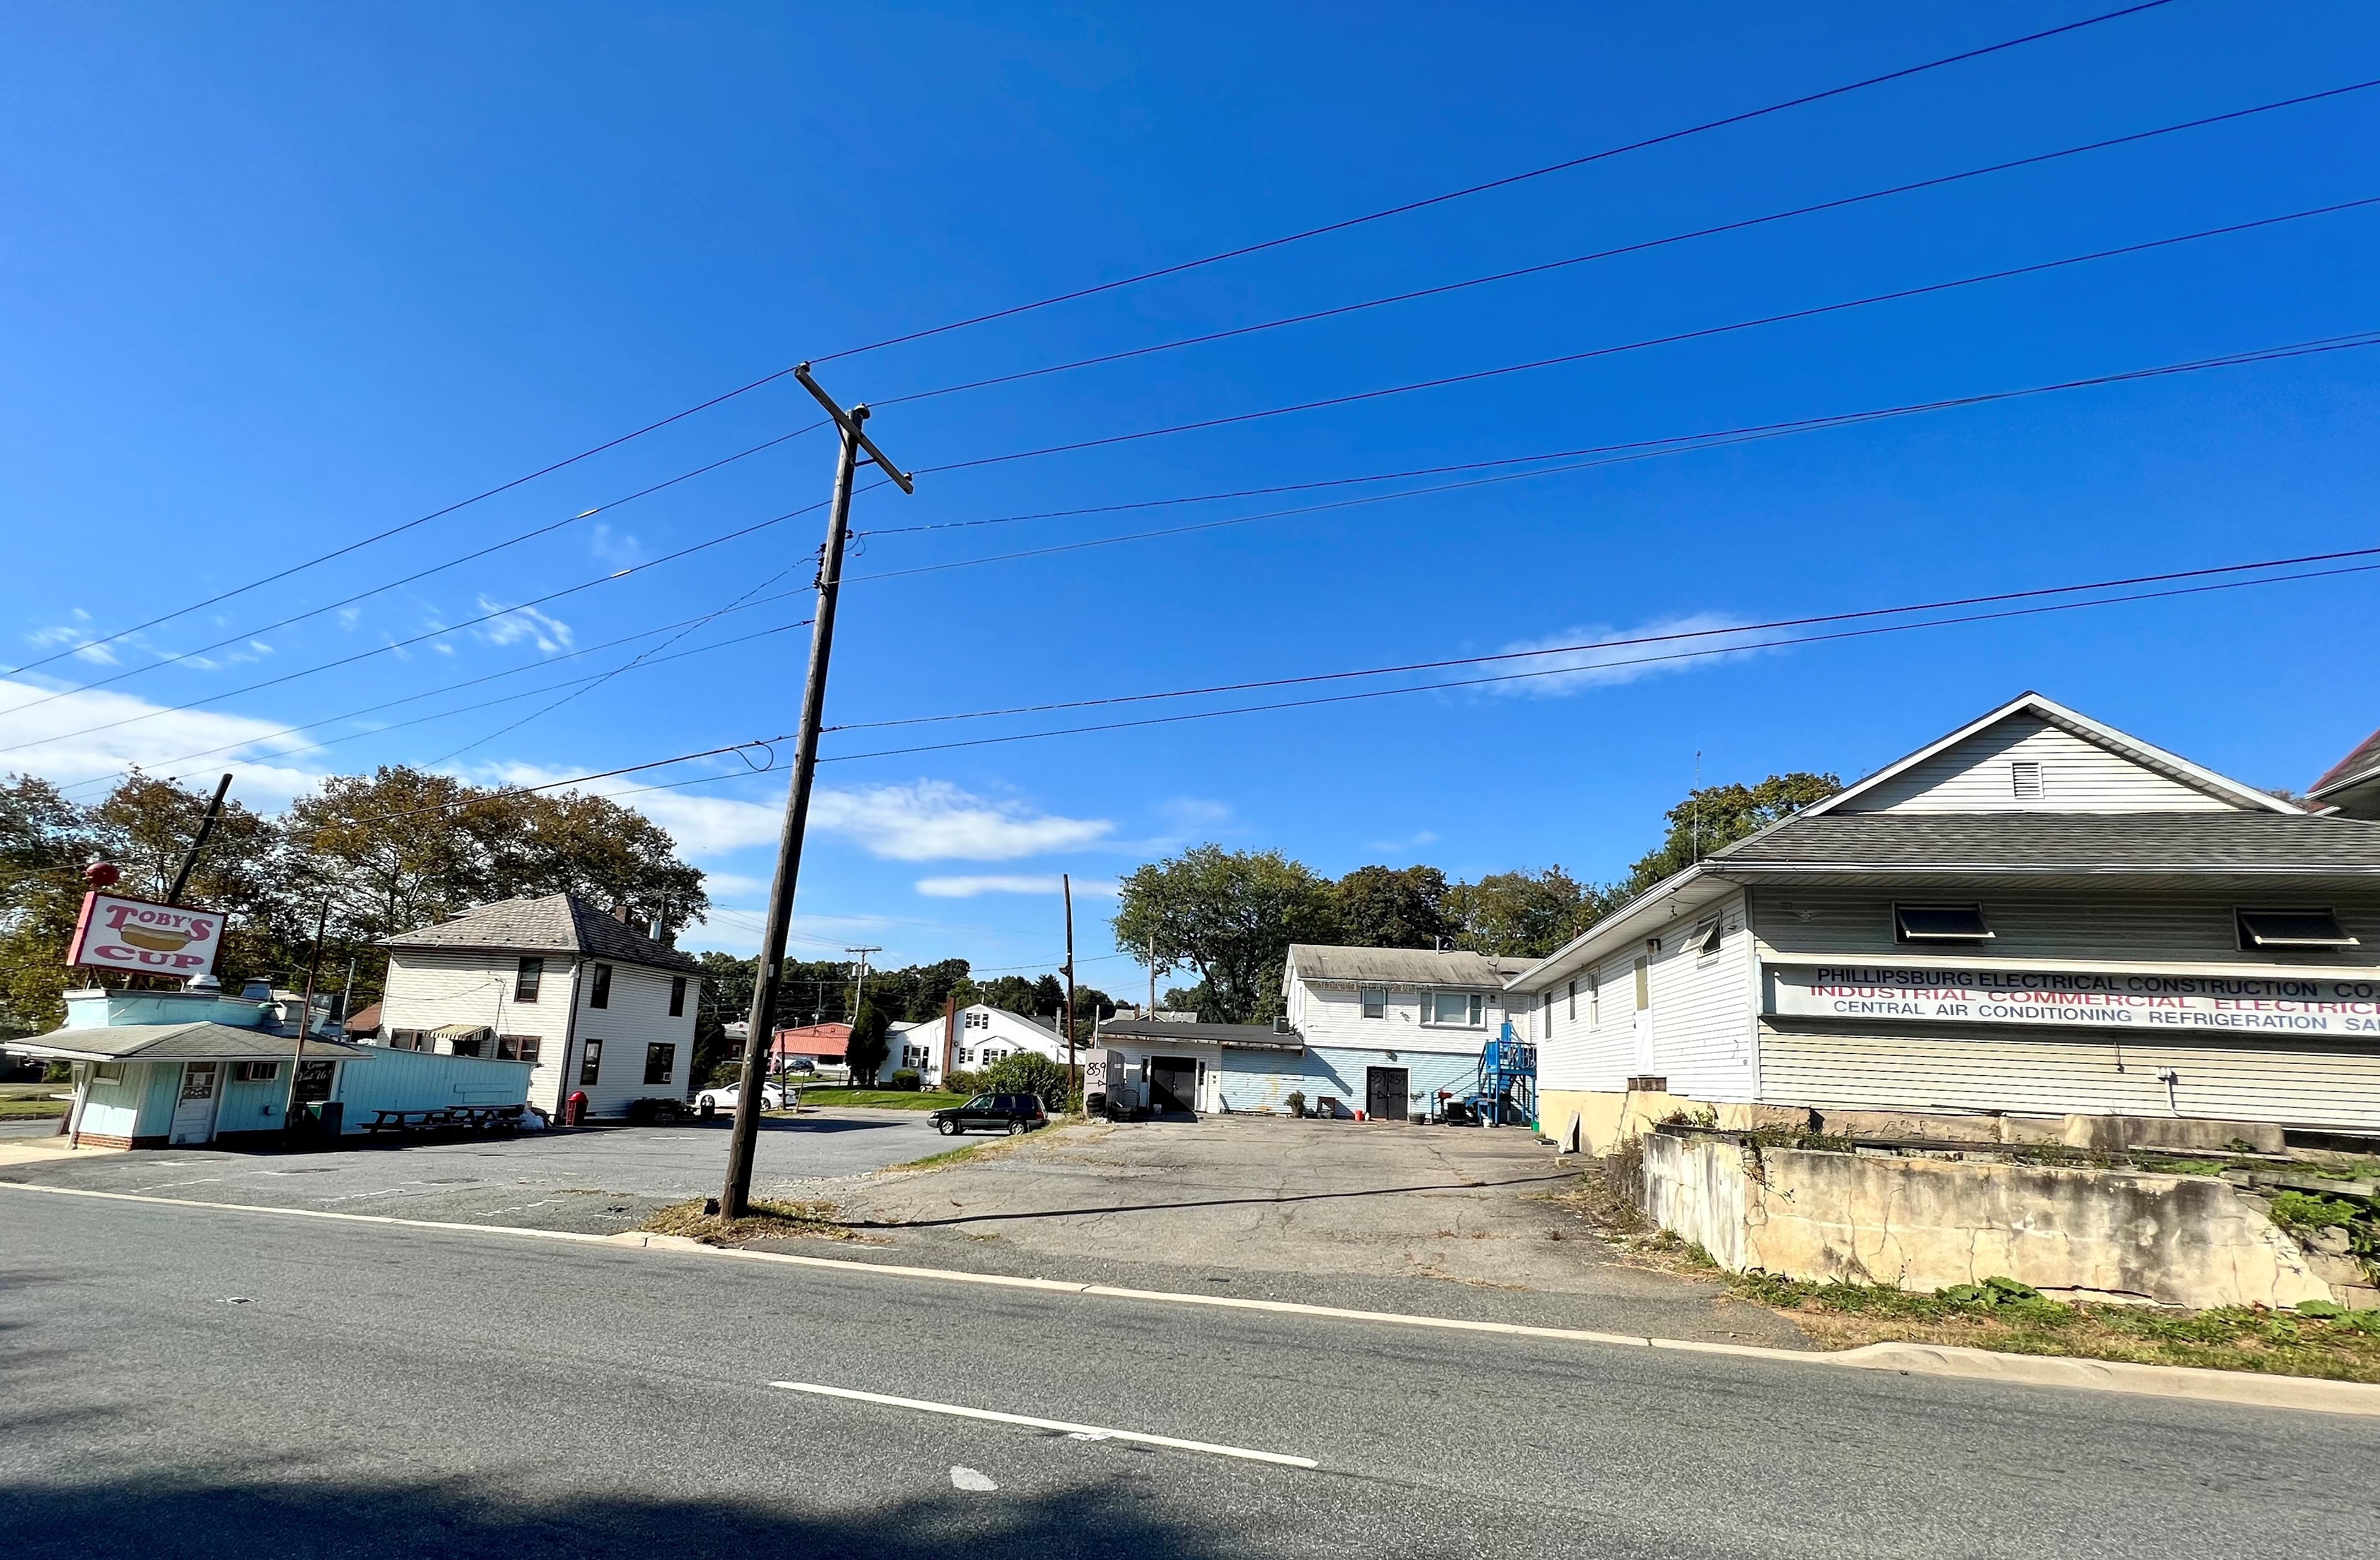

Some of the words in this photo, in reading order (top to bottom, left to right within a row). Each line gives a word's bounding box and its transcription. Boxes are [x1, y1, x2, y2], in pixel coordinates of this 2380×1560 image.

[105, 905, 213, 941] TOBY'S
[94, 946, 204, 968] CUP
[1818, 968, 1973, 985] PHILLIPSBURG
[1979, 973, 2121, 990] ELECTRICAL
[2128, 976, 2318, 997] CONSTRUCTION
[1811, 985, 1976, 1001] INDUSTRIAL
[1988, 990, 2196, 1008] COMMERCIAL
[1834, 1001, 1925, 1015] CENTRAL
[1936, 1004, 1968, 1016] AIR
[1979, 1005, 2132, 1022] CONDITIONING
[2149, 1011, 2327, 1029] REFRIGERATION
[1087, 1062, 1106, 1079] 859
[1390, 1074, 1406, 1086] 859
